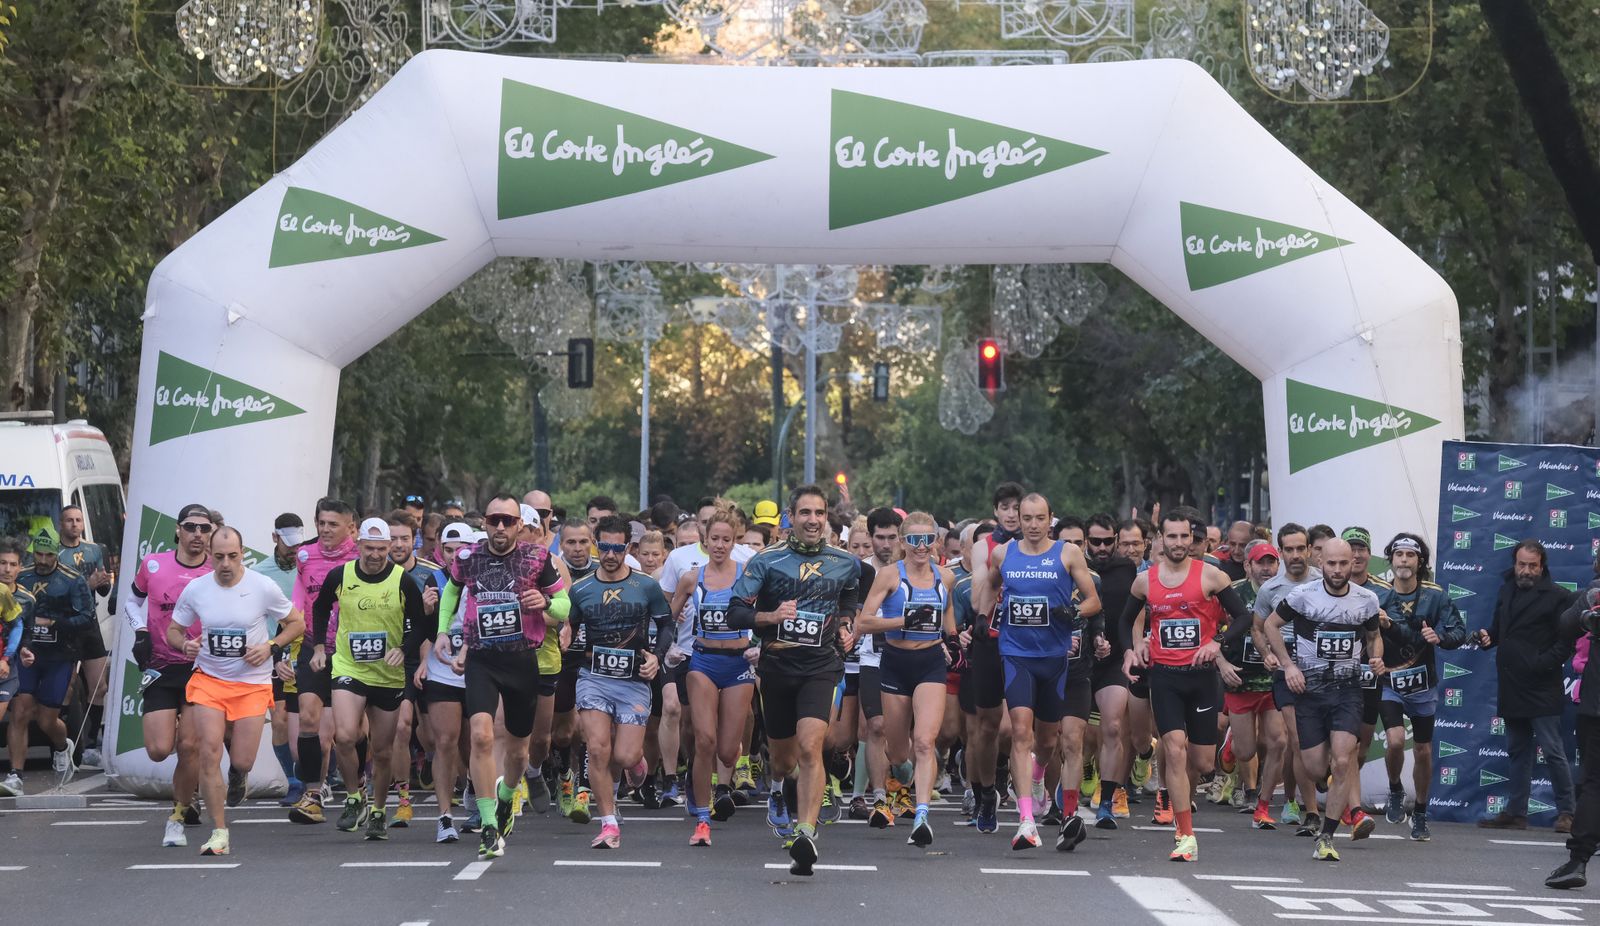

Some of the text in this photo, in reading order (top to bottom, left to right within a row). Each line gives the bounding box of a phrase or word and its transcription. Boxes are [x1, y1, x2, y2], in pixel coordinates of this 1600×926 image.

[504, 124, 714, 176] El Corte Inglés
[834, 128, 1047, 180] El Corte Inglés
[280, 213, 410, 247] El Corte Inglés
[1186, 227, 1319, 259] El Corte Inglés
[156, 384, 276, 418] El Corte Inglés
[1290, 405, 1411, 438] El Corte Inglés
[1006, 571, 1058, 579] TROTASIERRA
[1012, 604, 1043, 616] 367
[482, 611, 516, 627] 345
[783, 618, 818, 635] 636
[1165, 626, 1196, 639] 165
[212, 636, 243, 649] 156
[352, 639, 383, 652] 548
[1321, 639, 1351, 651] 519
[598, 654, 629, 668] 105
[1396, 672, 1423, 688] 571
[123, 695, 134, 716] El
